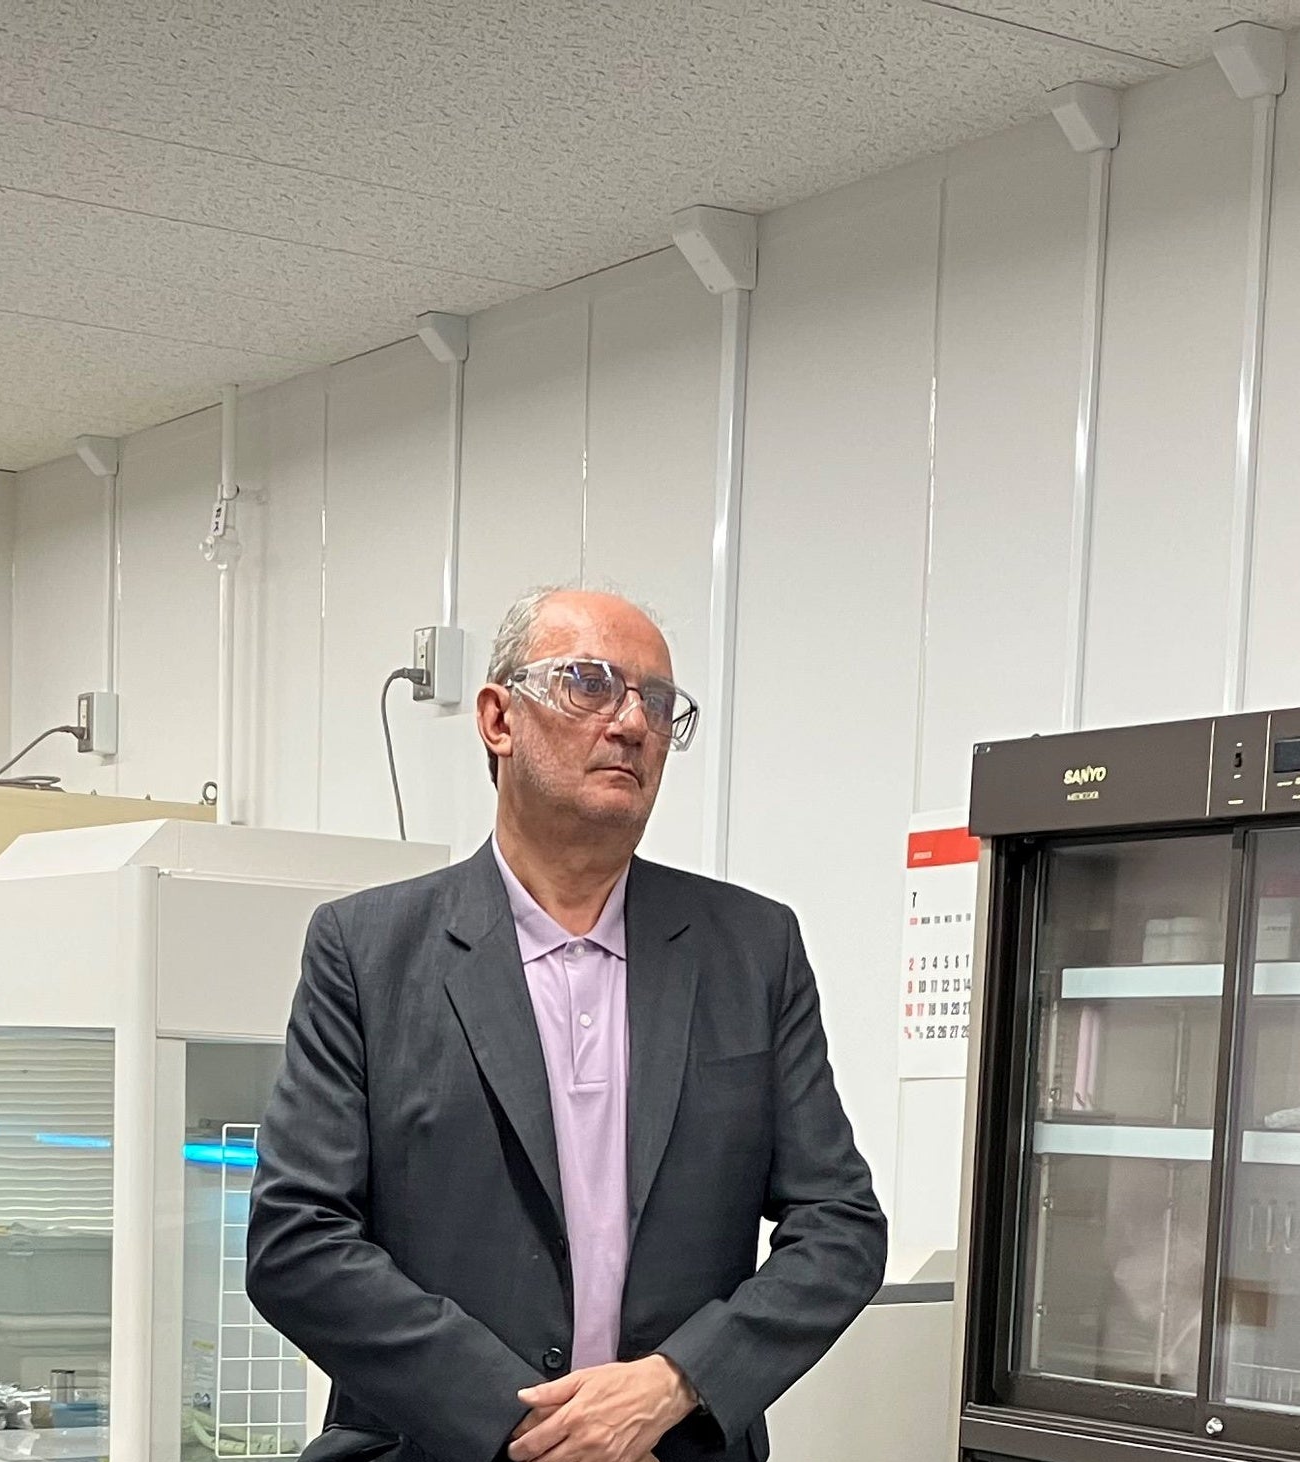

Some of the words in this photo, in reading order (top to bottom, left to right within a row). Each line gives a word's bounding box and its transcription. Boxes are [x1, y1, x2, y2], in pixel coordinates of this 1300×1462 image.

[1063, 765, 1107, 785] SANYO
[909, 958, 914, 971] 2
[921, 957, 926, 970] 3
[932, 956, 938, 969] 4
[944, 955, 949, 969] 5
[919, 980, 926, 993] 10
[941, 979, 950, 992] 12
[926, 1026, 935, 1039] 25
[937, 1026, 947, 1038] 26
[950, 1025, 959, 1038] 27
